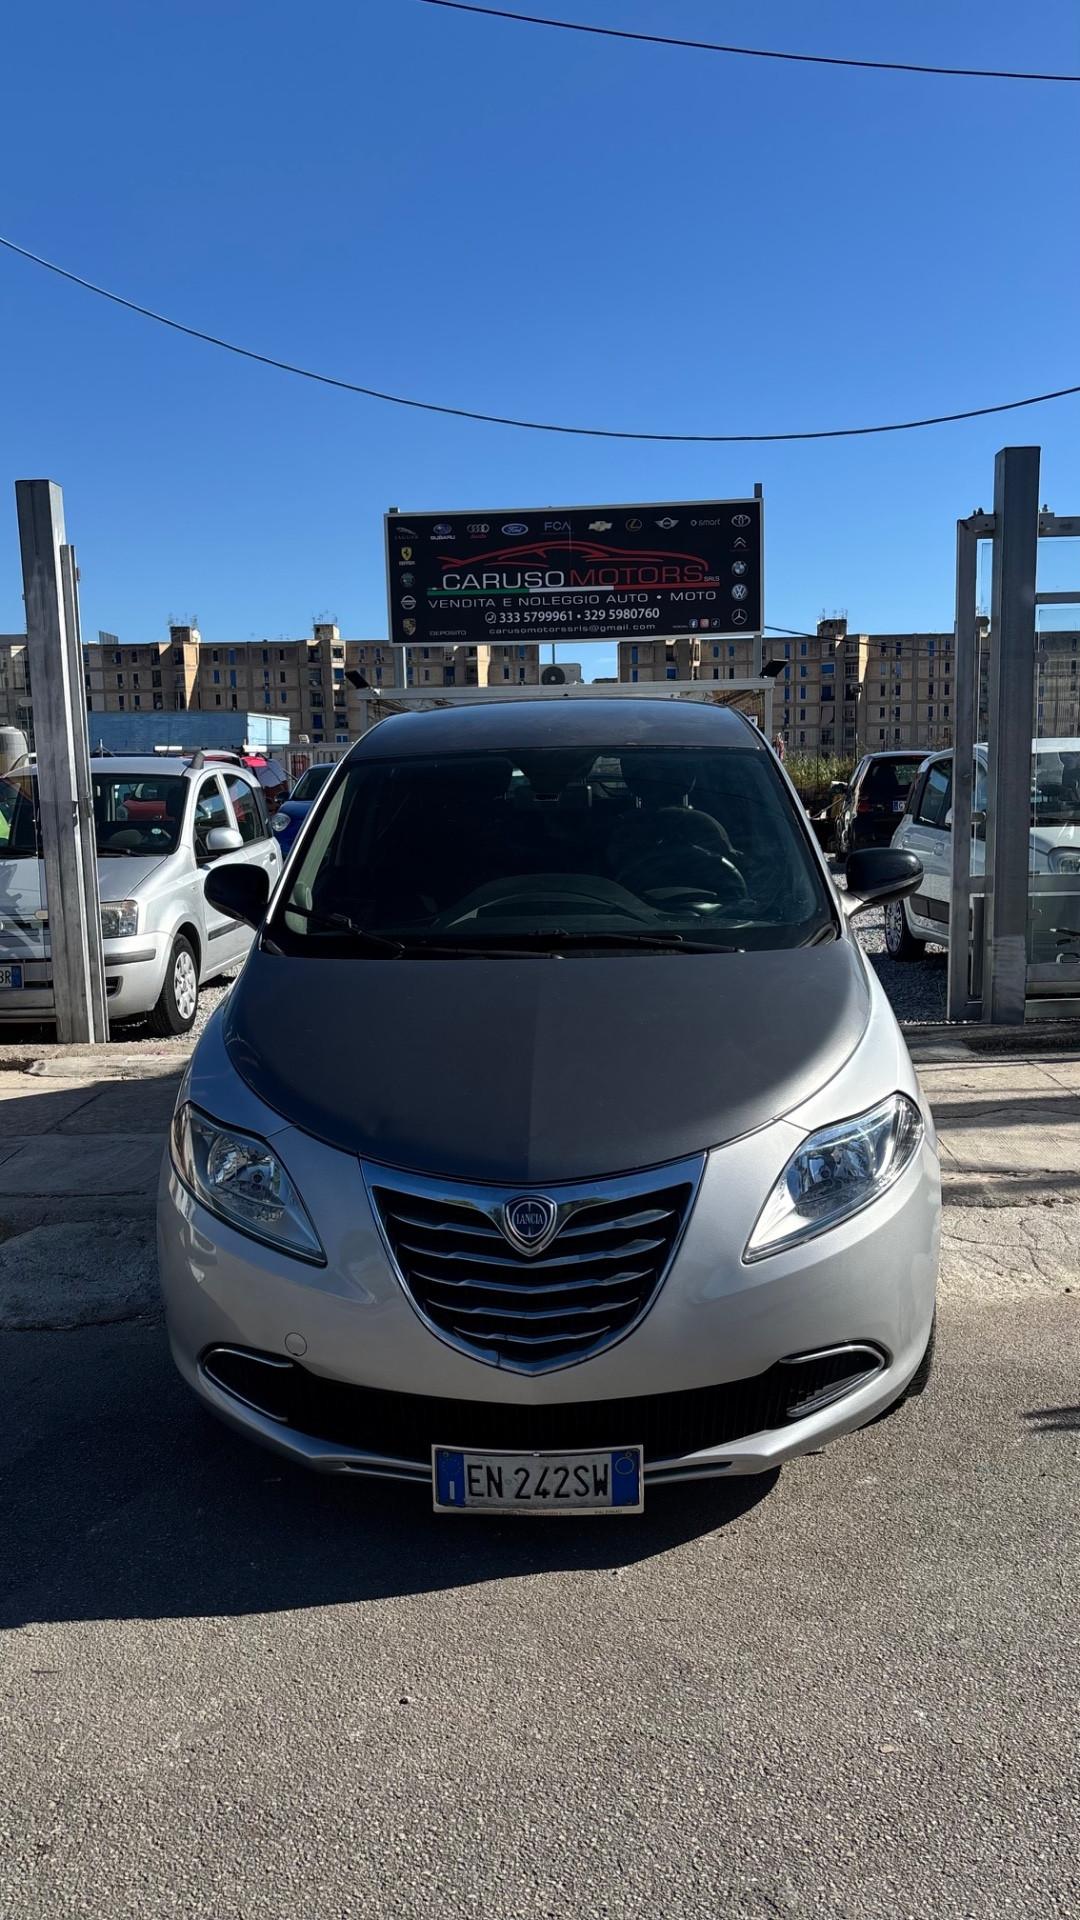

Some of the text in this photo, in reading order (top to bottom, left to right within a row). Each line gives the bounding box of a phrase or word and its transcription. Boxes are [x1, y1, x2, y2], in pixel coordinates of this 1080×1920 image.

[544, 521, 571, 532] FCA
[428, 591, 717, 609] VENDITA E NOLEGGIO AUTO MOTO
[499, 607, 660, 623] 333 5799961 329 5980760
[516, 1213, 544, 1225] LANCIA
[466, 1464, 609, 1500] EN 242SW
